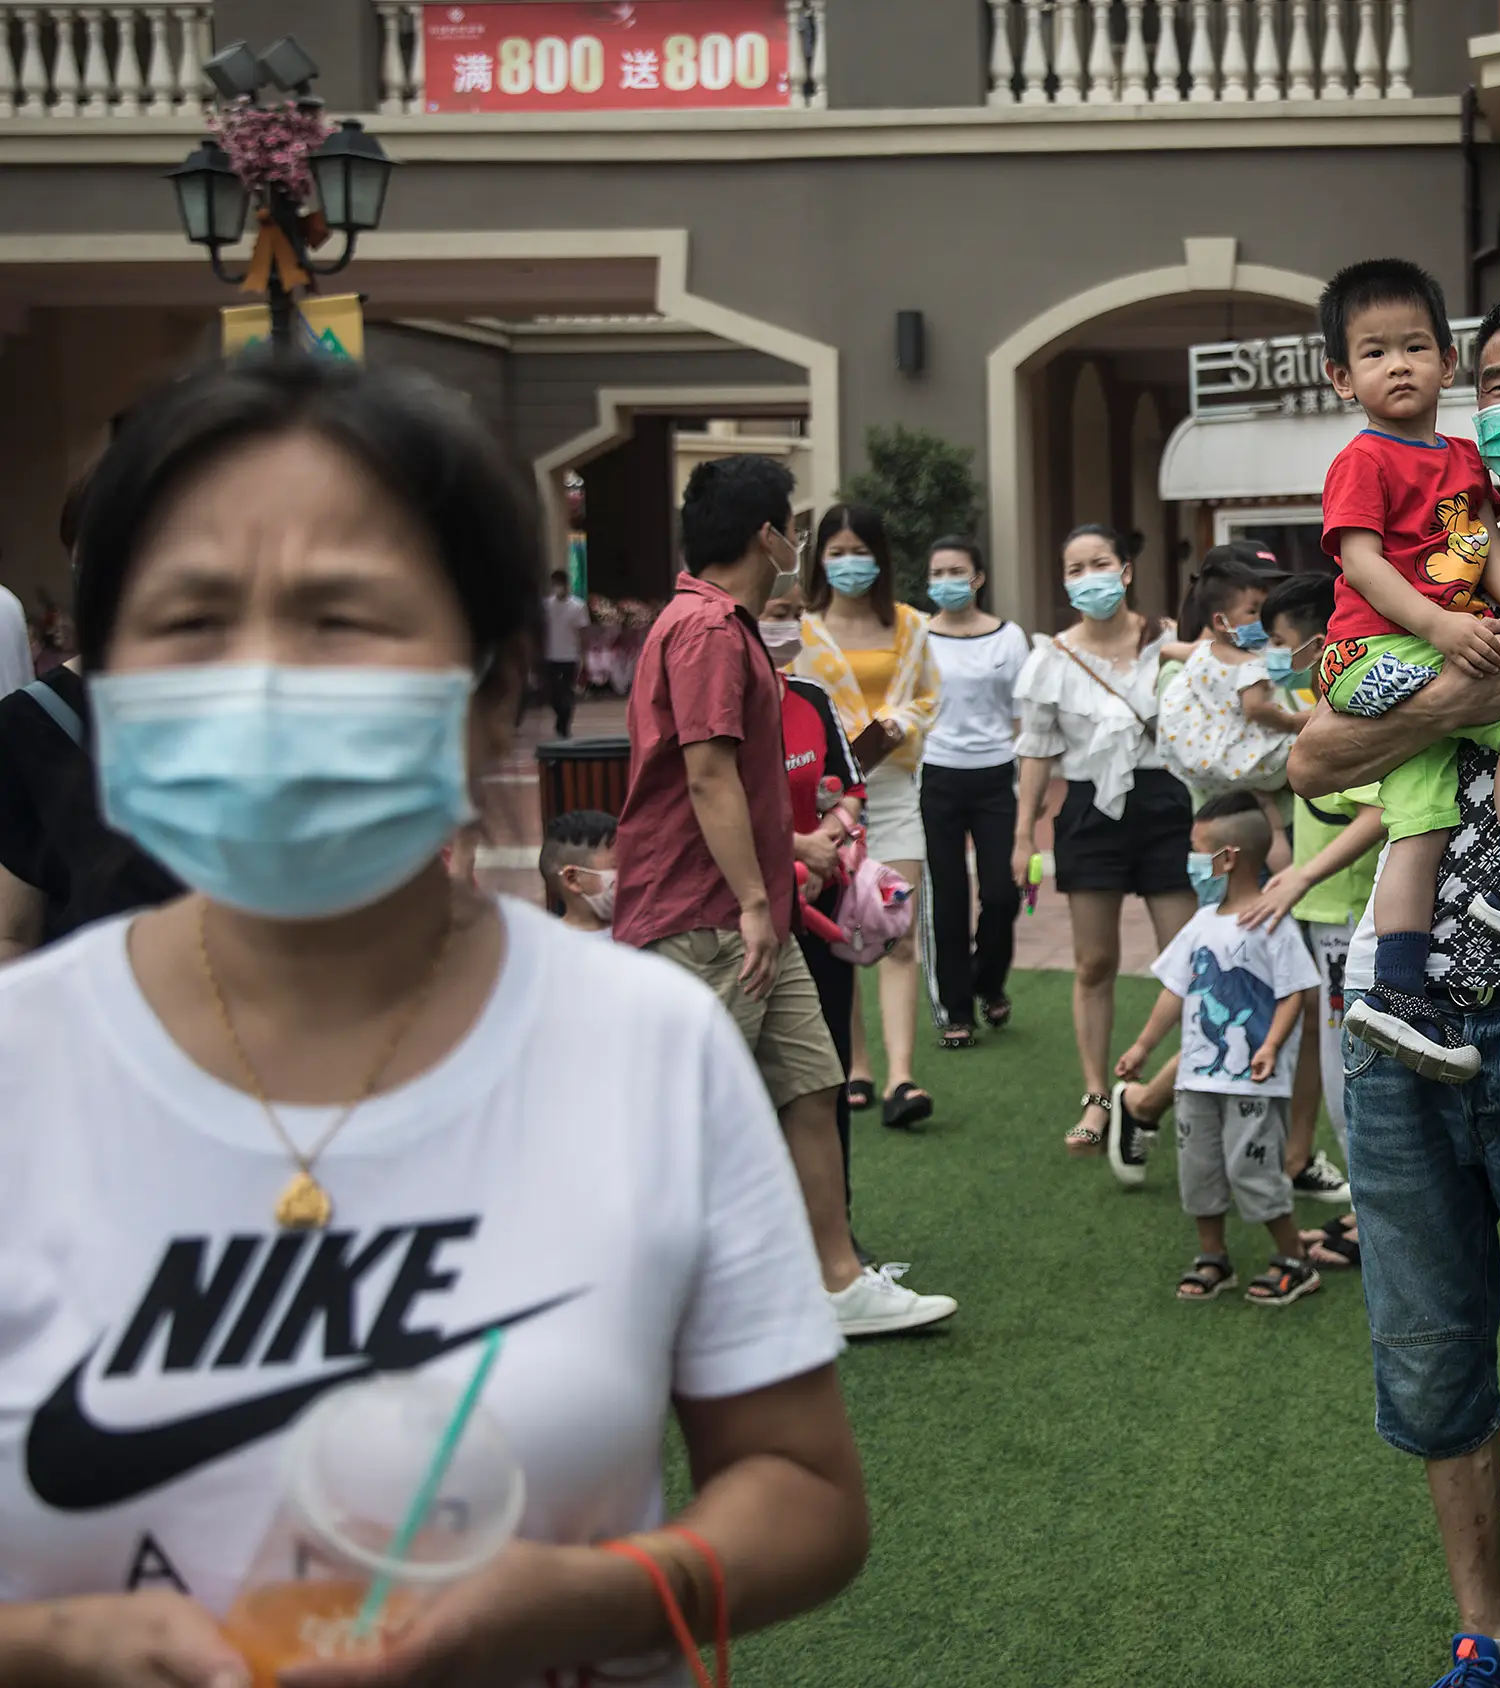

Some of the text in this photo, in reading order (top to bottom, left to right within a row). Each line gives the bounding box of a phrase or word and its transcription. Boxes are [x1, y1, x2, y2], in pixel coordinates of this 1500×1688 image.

[453, 32, 769, 95] 满 800 送 800
[101, 1214, 483, 1379] NIKE
